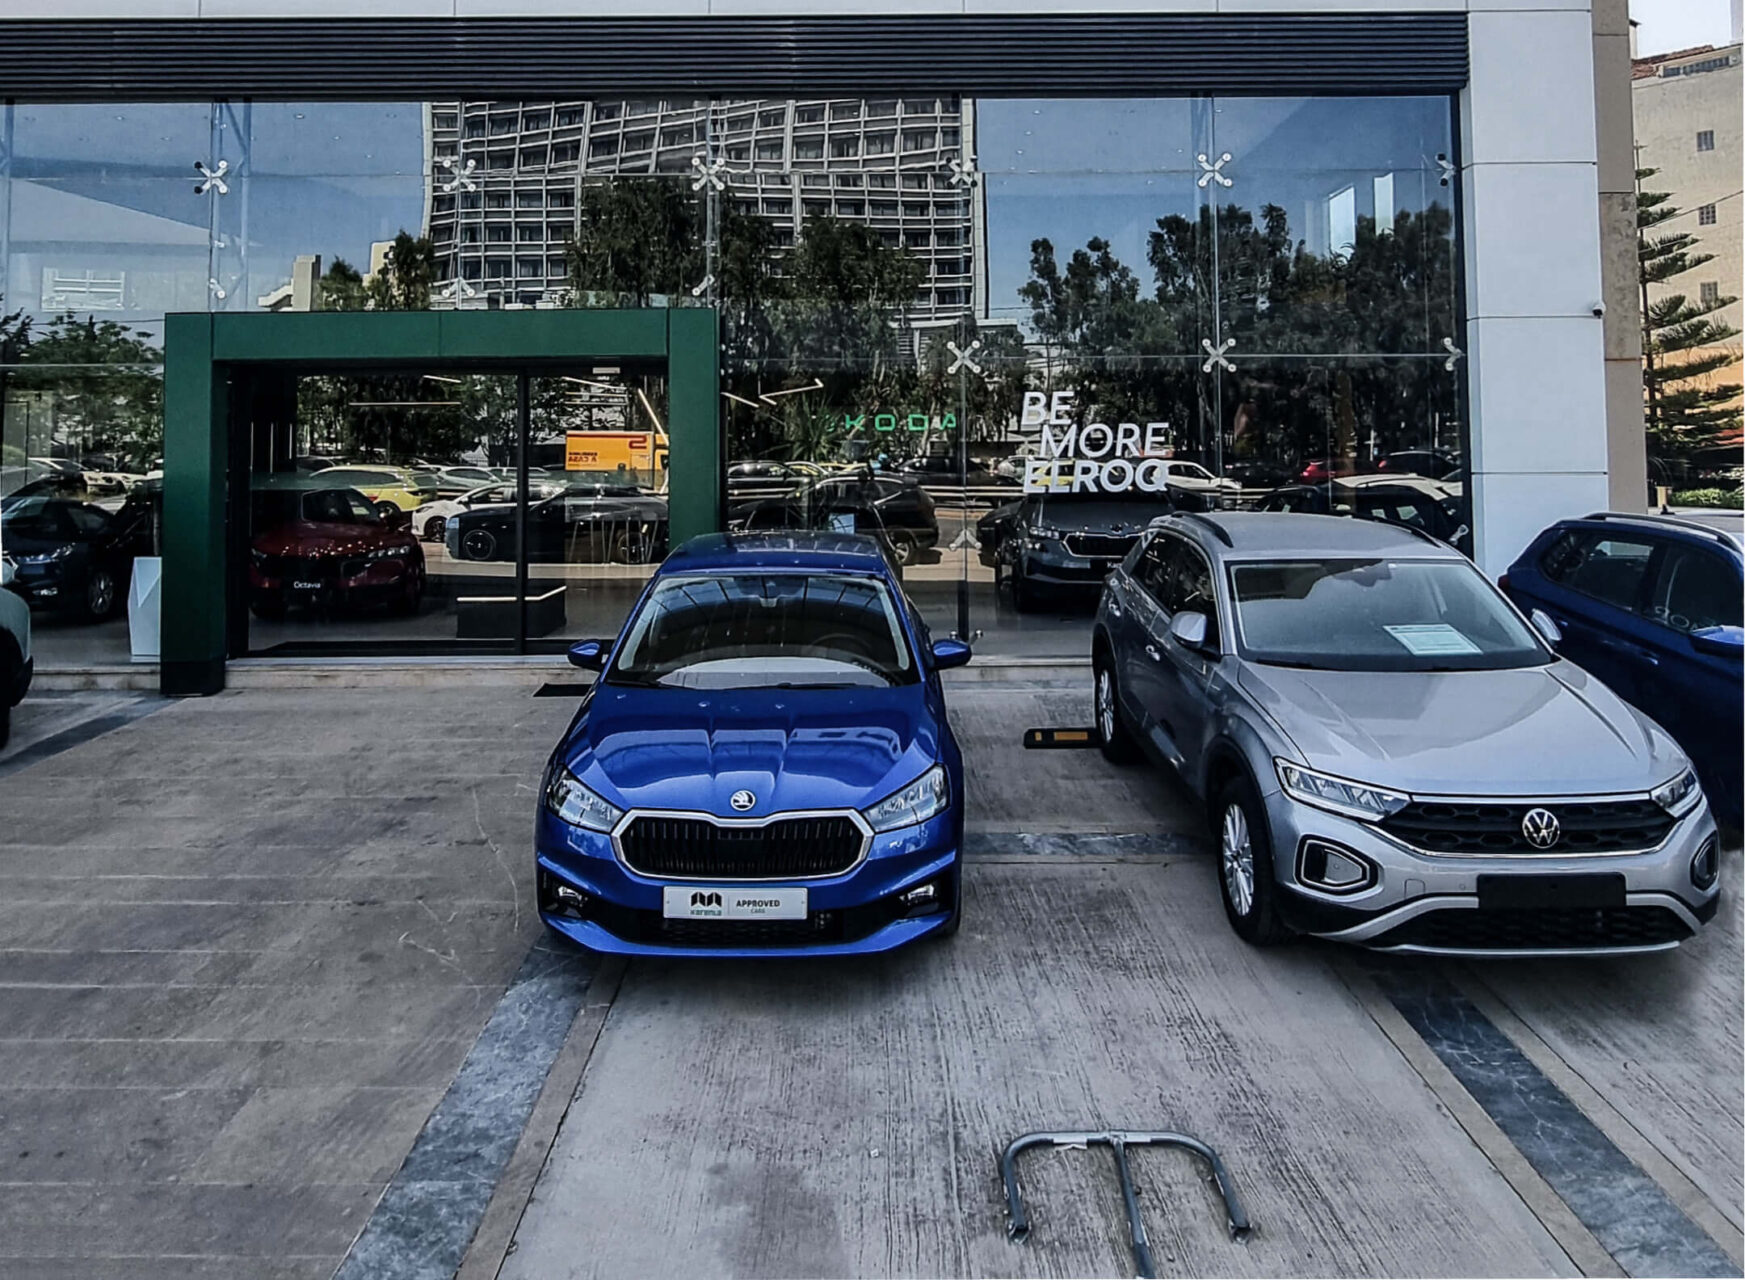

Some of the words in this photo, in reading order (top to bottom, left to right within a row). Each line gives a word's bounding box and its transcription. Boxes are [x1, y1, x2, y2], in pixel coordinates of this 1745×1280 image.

[1021, 391, 1075, 426] BE
[1040, 422, 1170, 458] MORE
[1023, 458, 1169, 493] ELROQ
[735, 899, 781, 908] APPROVED
